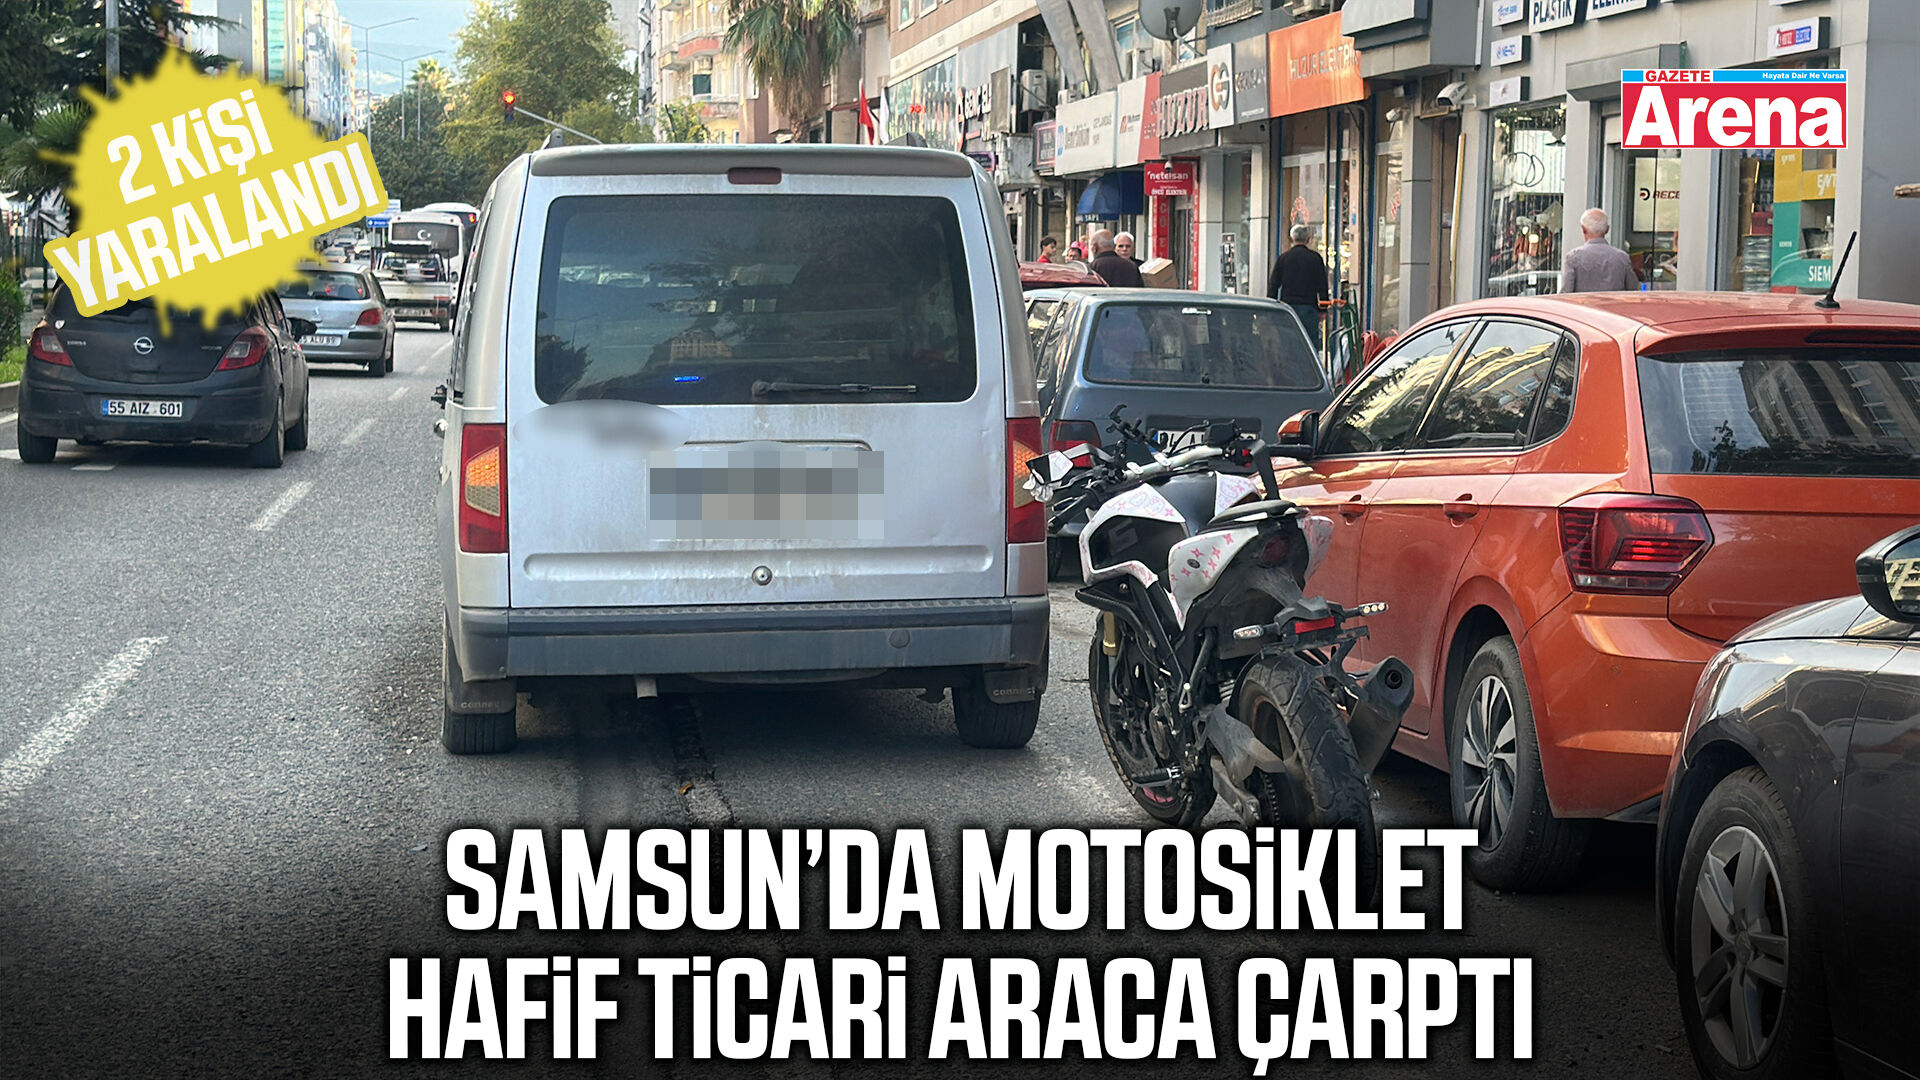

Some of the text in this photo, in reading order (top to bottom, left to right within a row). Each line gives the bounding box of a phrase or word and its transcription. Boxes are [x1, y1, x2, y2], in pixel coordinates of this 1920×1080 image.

[1155, 84, 1209, 139] HUZUR
[1808, 264, 1832, 282] SIEM
[109, 401, 181, 415] 55 AIZ 601
